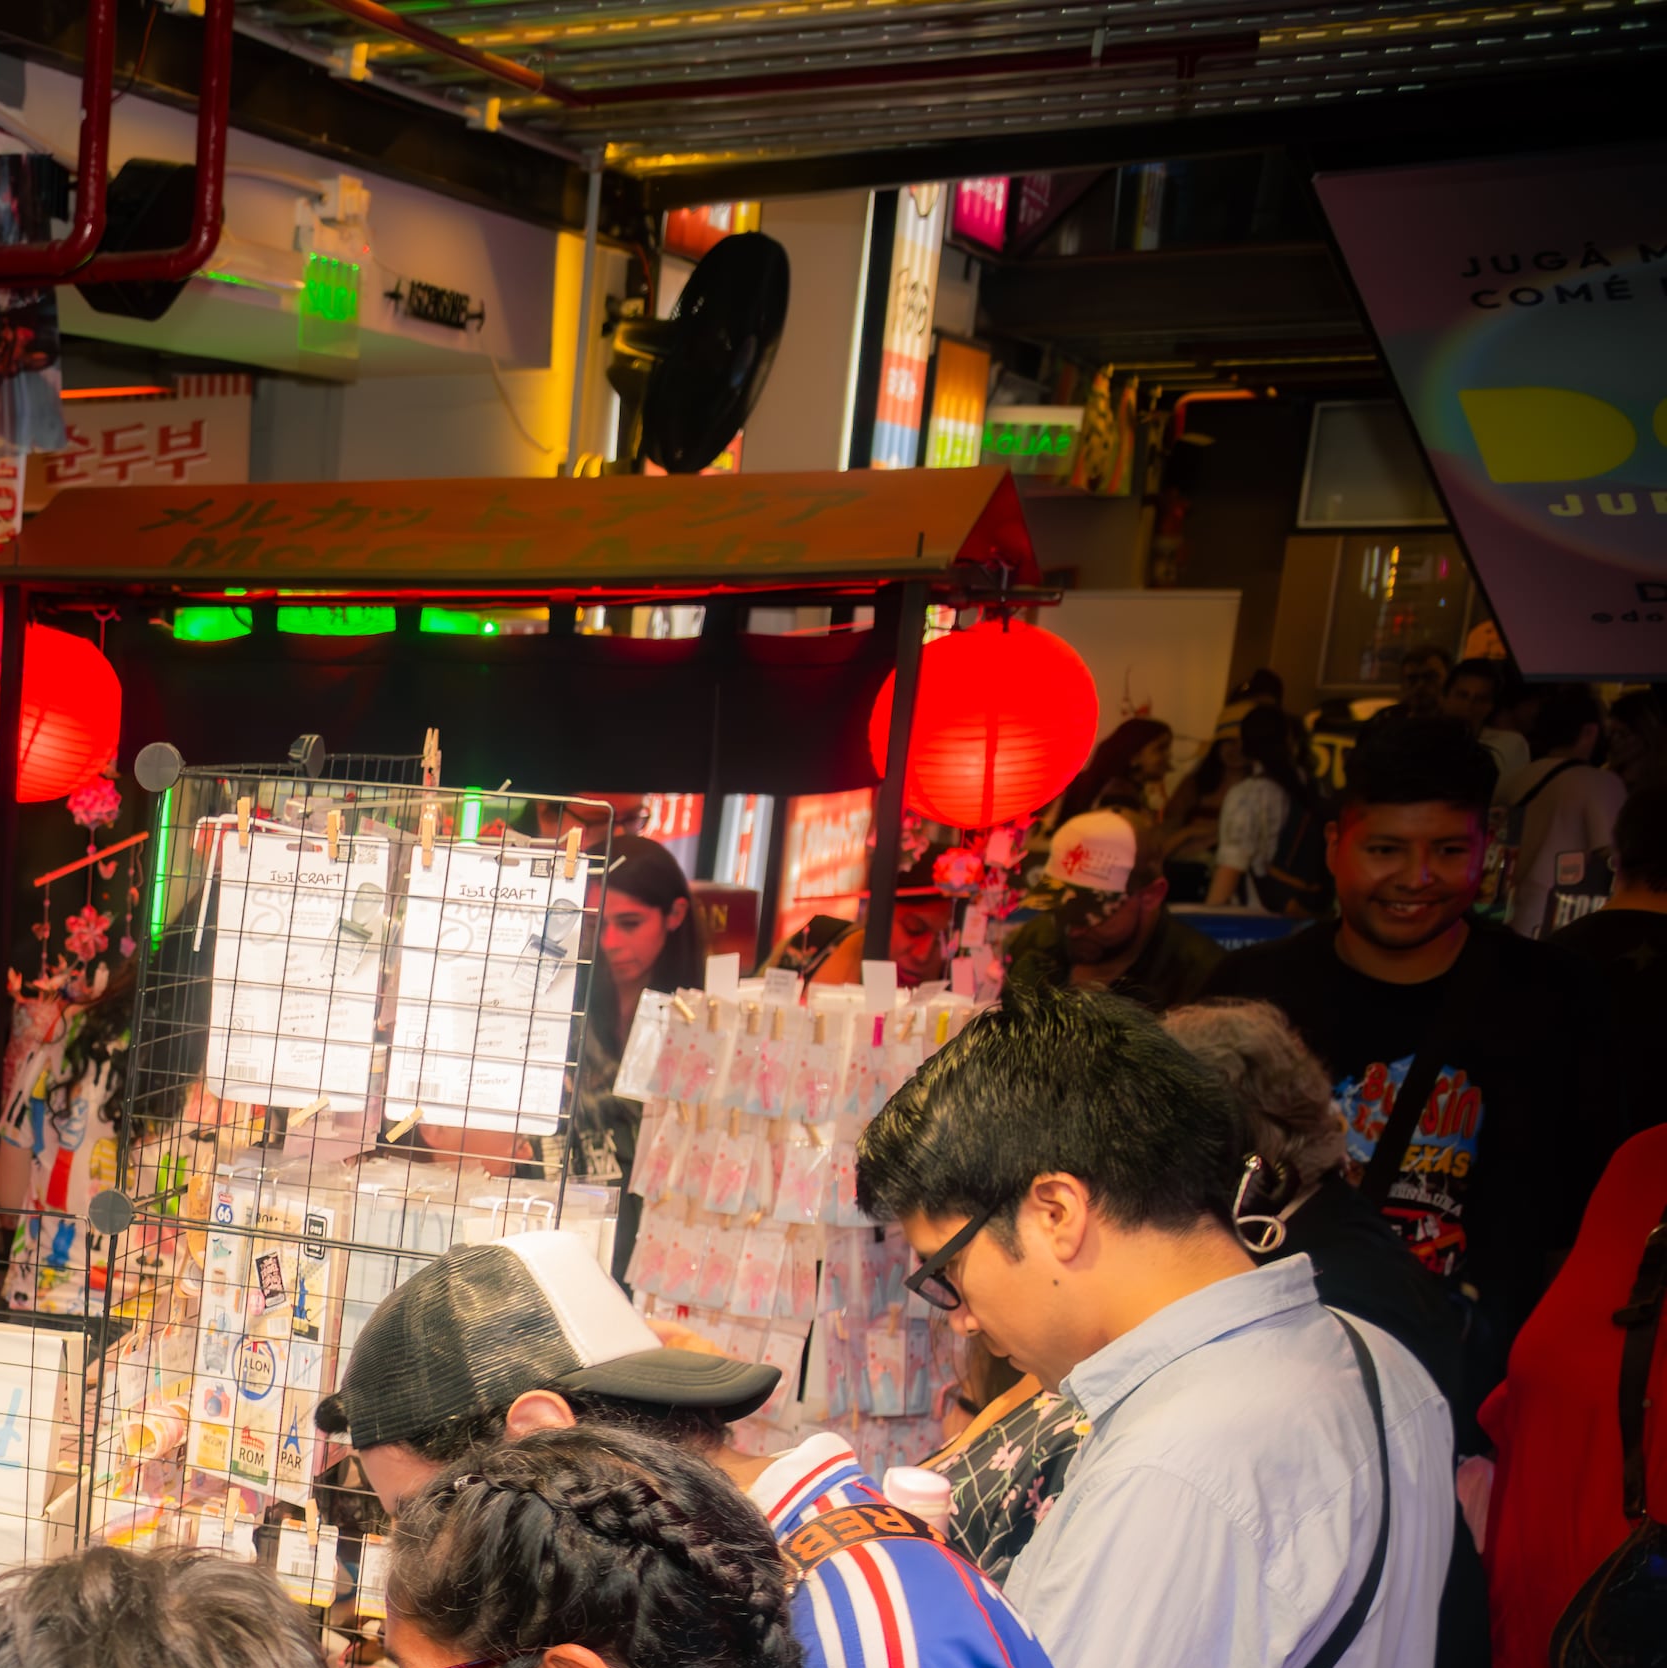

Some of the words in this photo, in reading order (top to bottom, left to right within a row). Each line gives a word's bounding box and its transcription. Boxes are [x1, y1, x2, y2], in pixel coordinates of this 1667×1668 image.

[217, 1206, 233, 1224] 66
[238, 1447, 266, 1468] ROM
[280, 1451, 303, 1471] PAR
